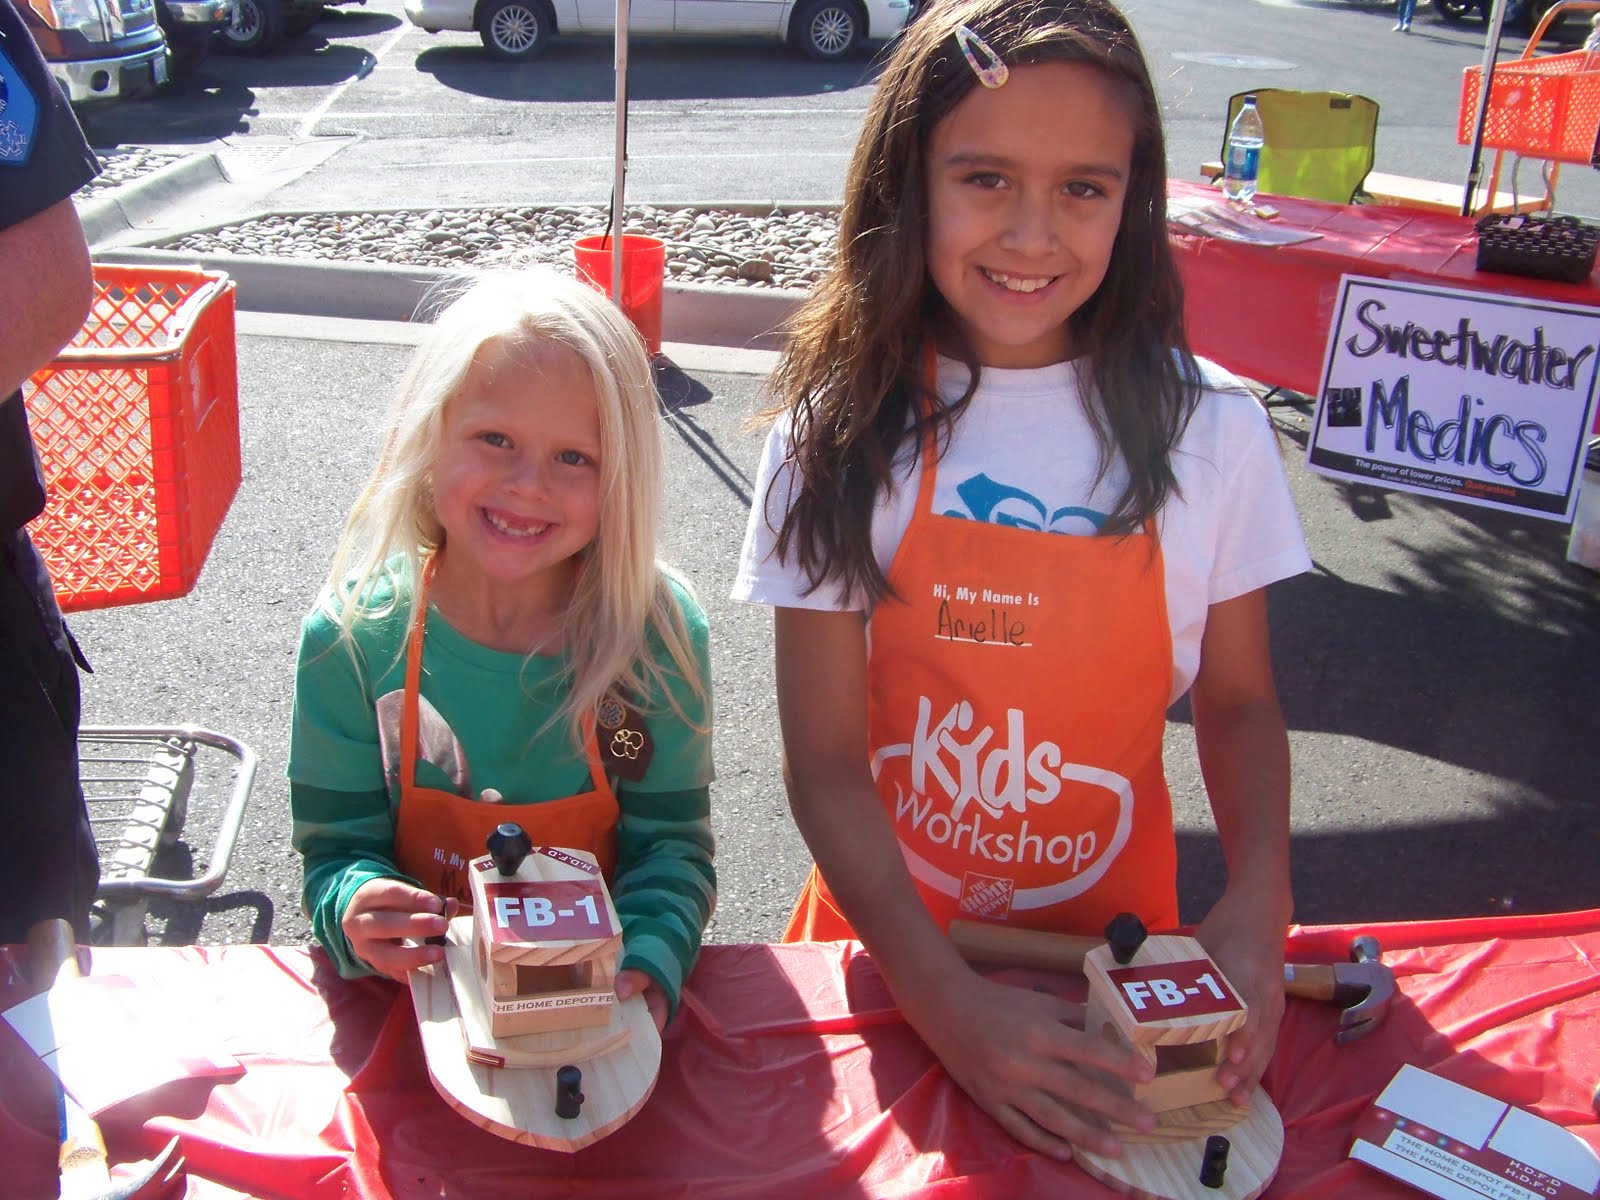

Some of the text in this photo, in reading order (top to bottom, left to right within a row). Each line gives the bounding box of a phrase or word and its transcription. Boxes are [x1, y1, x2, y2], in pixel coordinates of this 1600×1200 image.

[1345, 299, 1594, 390] Sweetwater
[1365, 374, 1547, 486] Medics
[1355, 458, 1371, 469] The
[1371, 463, 1399, 475] power
[1410, 469, 1434, 480] lower
[933, 584, 1040, 606] Hi, My Name Is
[937, 599, 1025, 646] Arielle
[433, 847, 446, 865] Hi,
[450, 852, 466, 871] My
[493, 895, 601, 929] FB-1
[517, 1000, 553, 1011] HOME
[556, 996, 596, 1007] DEPOT
[1121, 973, 1226, 1010] FB-1
[1395, 1143, 1419, 1159] THE
[1419, 1155, 1456, 1176] HOME
[1456, 1172, 1498, 1194] DEPOT
[1400, 1136, 1424, 1150] THE
[1425, 1147, 1460, 1167] HOME
[1461, 1164, 1503, 1187] DEPOT
